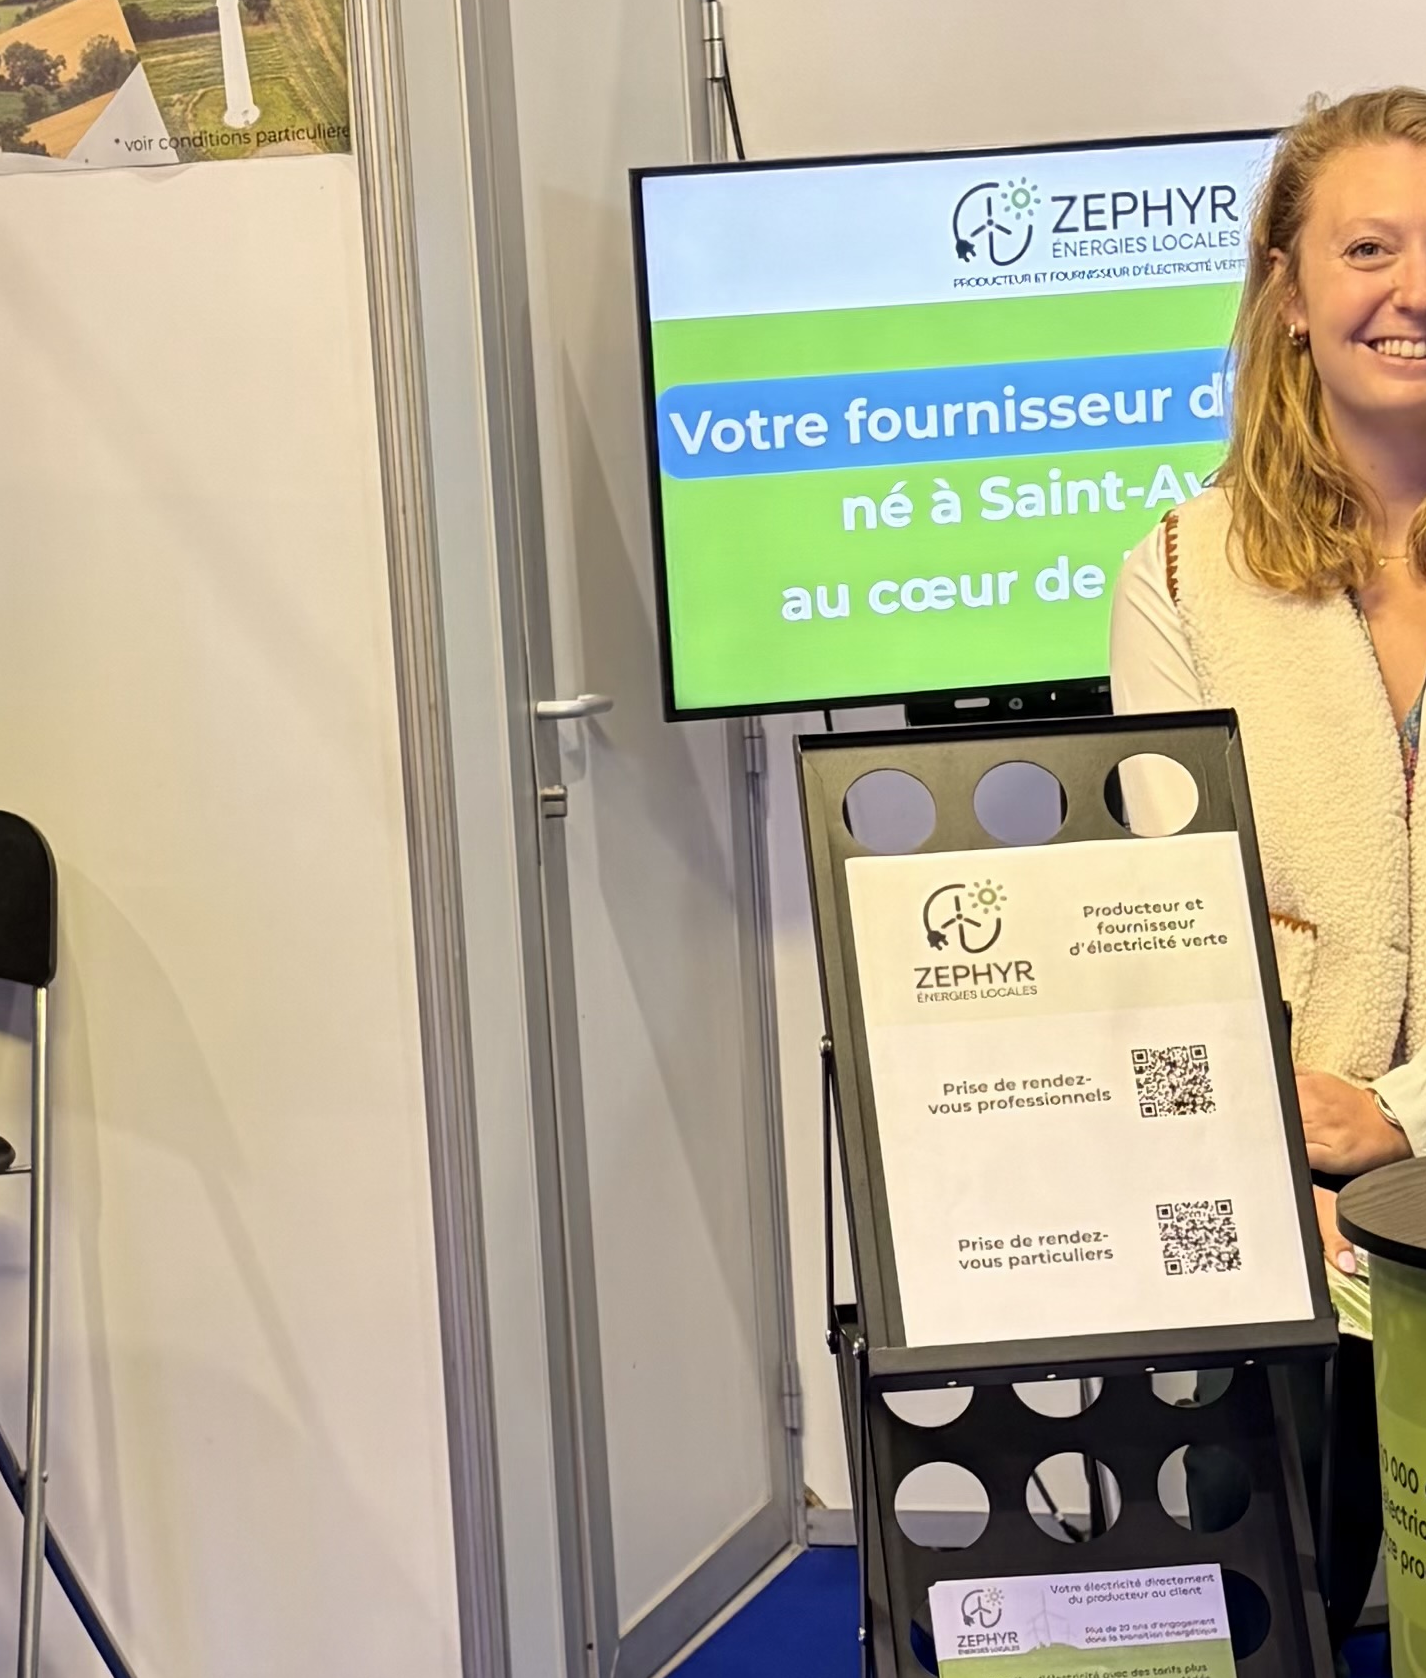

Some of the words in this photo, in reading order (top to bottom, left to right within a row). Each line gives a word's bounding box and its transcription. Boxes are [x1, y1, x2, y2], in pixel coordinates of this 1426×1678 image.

[124, 134, 153, 152] voir
[159, 129, 251, 150] conditions
[256, 122, 350, 146] particulière
[1051, 185, 1239, 233] ZEPHYR
[1051, 236, 1147, 259] ÉNERGIES
[1153, 230, 1241, 252] LOCALES
[668, 409, 829, 455] Votre
[844, 384, 1172, 444] fournisseur
[841, 481, 910, 532] né
[929, 475, 962, 525] à
[780, 583, 850, 623] au
[868, 570, 1019, 615] cœur
[1035, 556, 1106, 603] de
[977, 1088, 1112, 1115] professionnels
